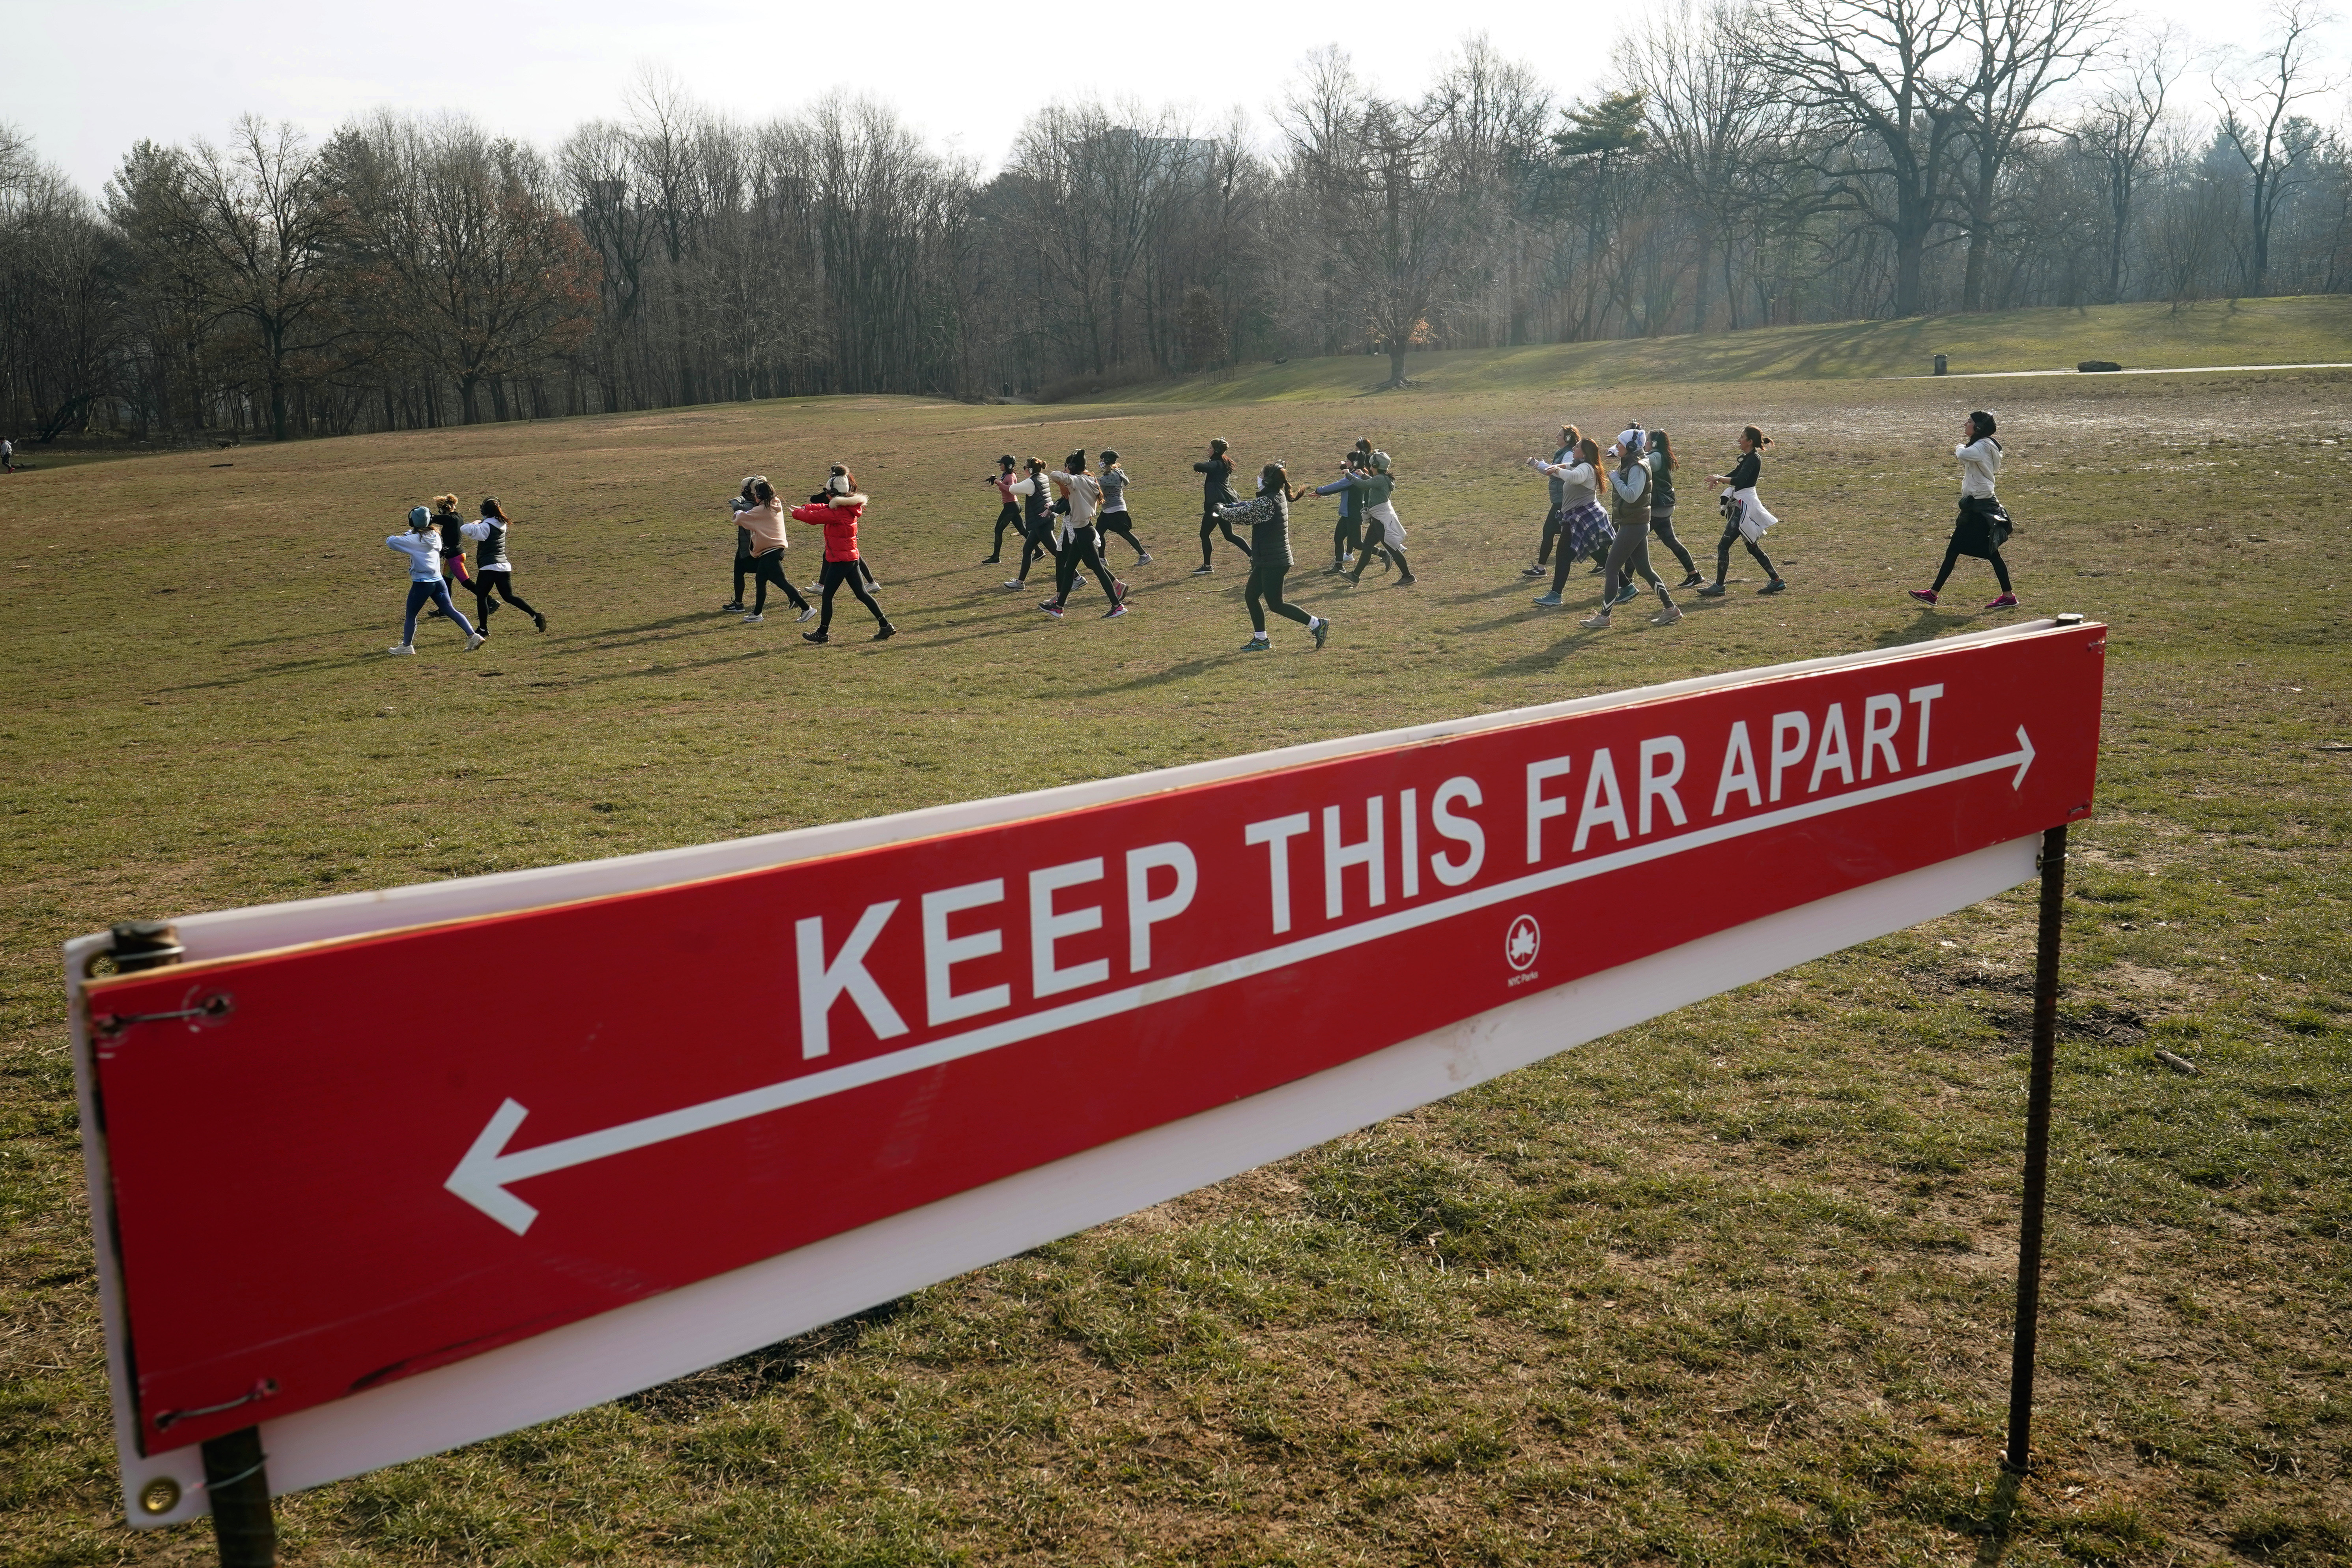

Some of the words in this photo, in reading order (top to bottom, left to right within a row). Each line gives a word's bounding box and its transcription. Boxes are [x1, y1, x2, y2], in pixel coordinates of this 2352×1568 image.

[796, 842, 1197, 1060] KEEP
[1245, 776, 1485, 934] THIS
[1527, 735, 1687, 864] FAR
[1712, 683, 1943, 816] APART
[1508, 975, 1521, 987] NYC
[1521, 971, 1539, 983] Parks
